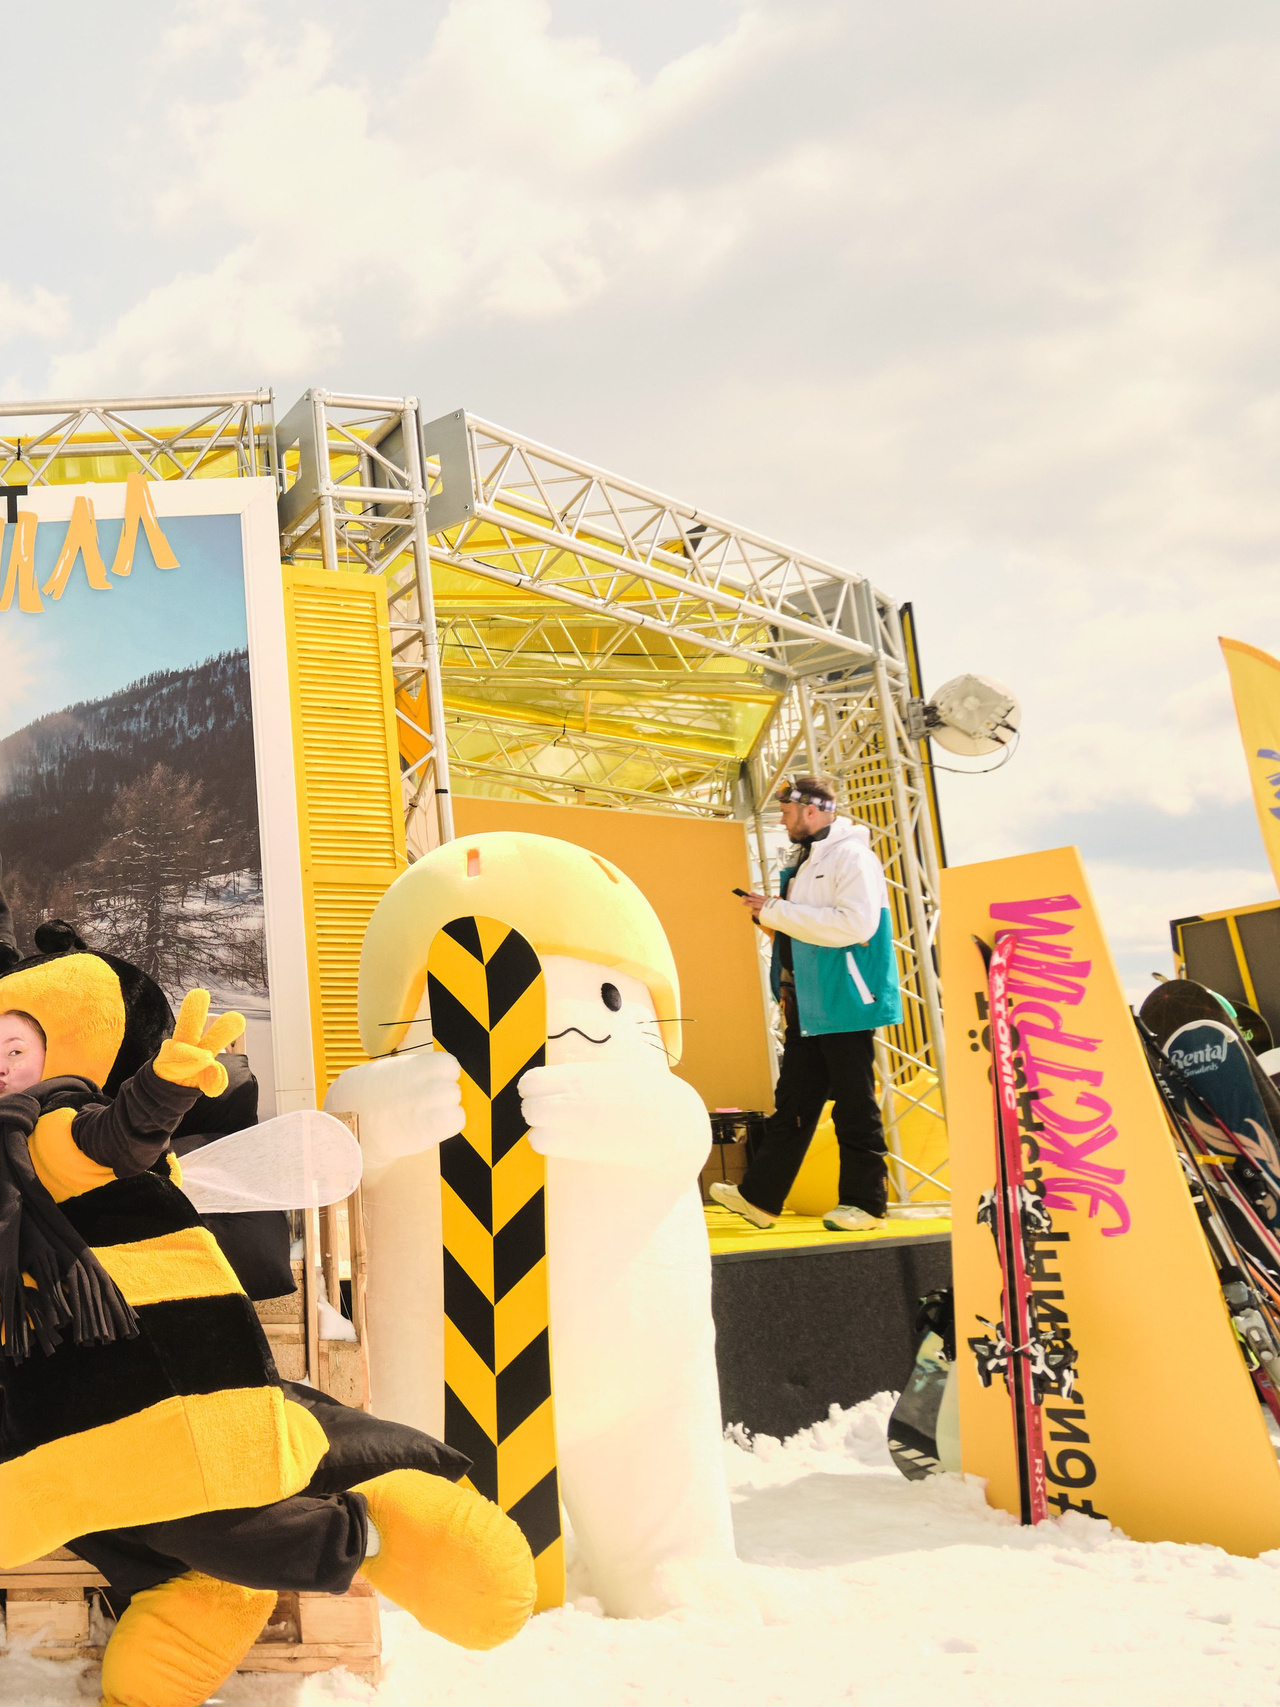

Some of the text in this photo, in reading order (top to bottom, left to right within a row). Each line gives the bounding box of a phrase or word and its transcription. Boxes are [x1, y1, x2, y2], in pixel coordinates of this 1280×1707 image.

[989, 894, 1131, 1238] ЭКСТРИМ
[993, 975, 1017, 1111] ATOMIC
[1171, 1041, 1228, 1070] Rental
[1034, 1458, 1045, 1493] RX
